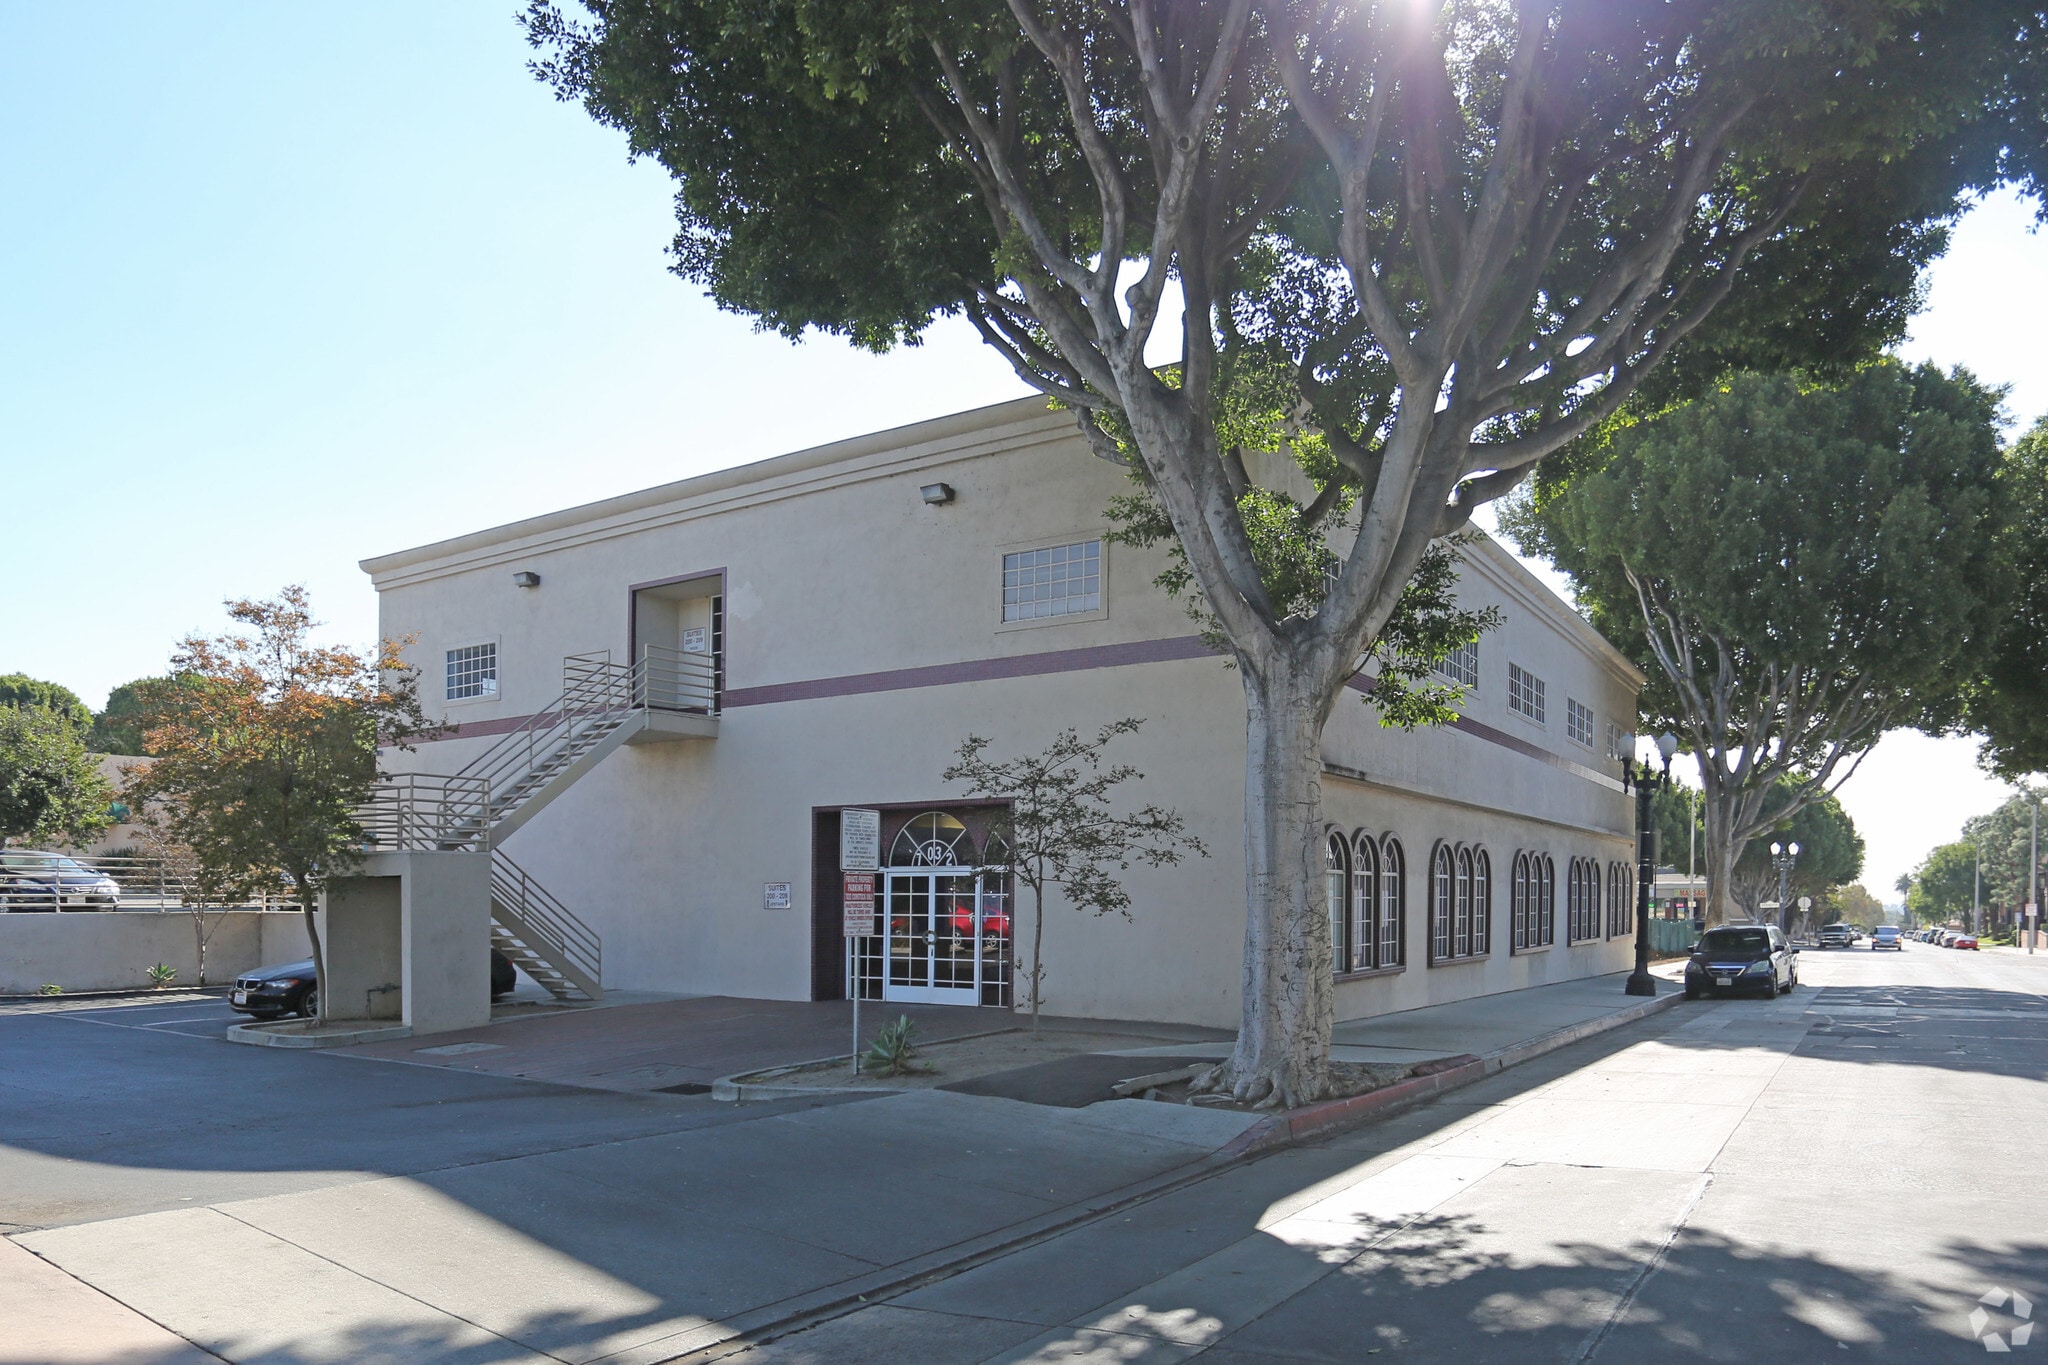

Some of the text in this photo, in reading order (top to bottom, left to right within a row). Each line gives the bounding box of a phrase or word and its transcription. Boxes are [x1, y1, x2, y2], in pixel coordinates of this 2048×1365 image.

[686, 630, 702, 638] SUITES
[847, 883, 872, 892] PARKING FOR
